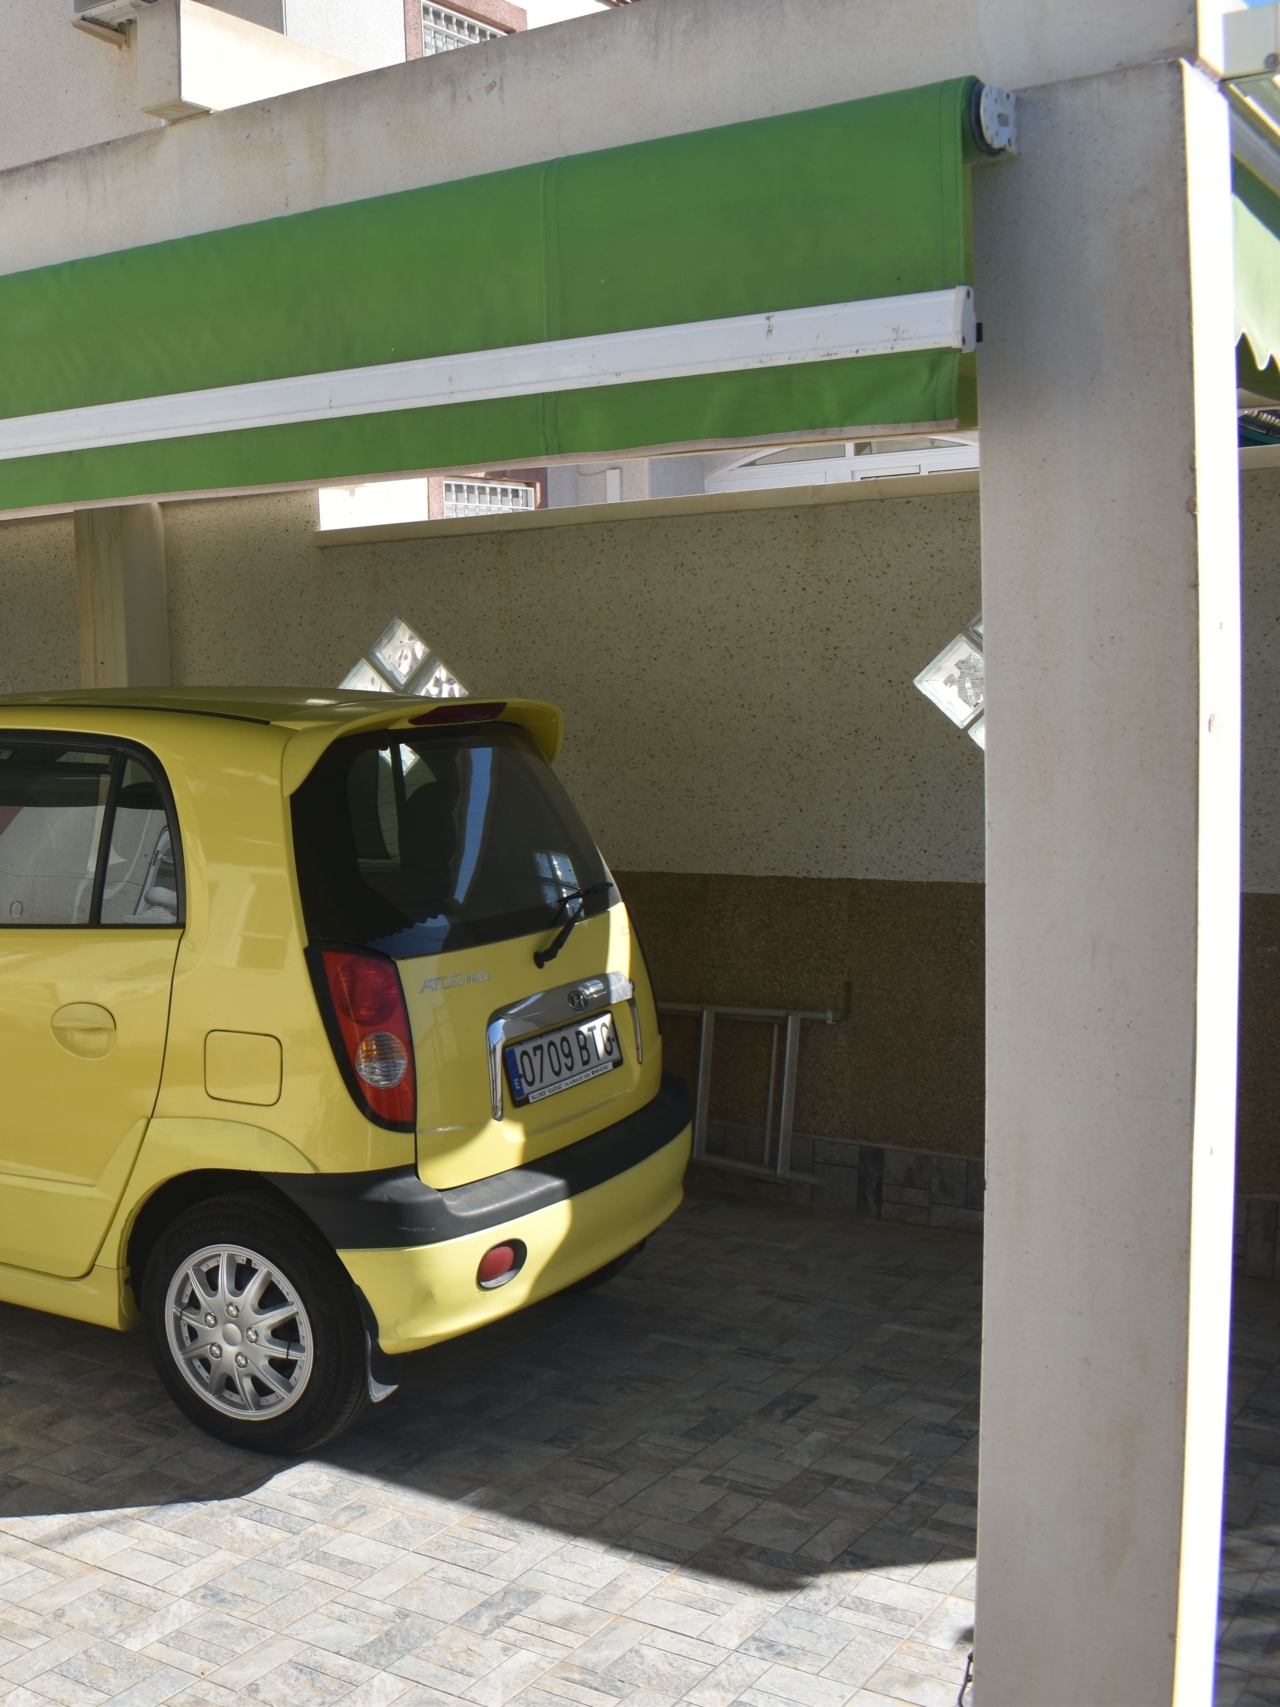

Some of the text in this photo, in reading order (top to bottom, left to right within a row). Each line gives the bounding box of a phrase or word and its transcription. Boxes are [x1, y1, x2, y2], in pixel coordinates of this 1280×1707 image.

[419, 970, 490, 994] ATOS PRIME
[520, 1022, 613, 1087] 0709 BTG
[514, 1079, 520, 1089] E
